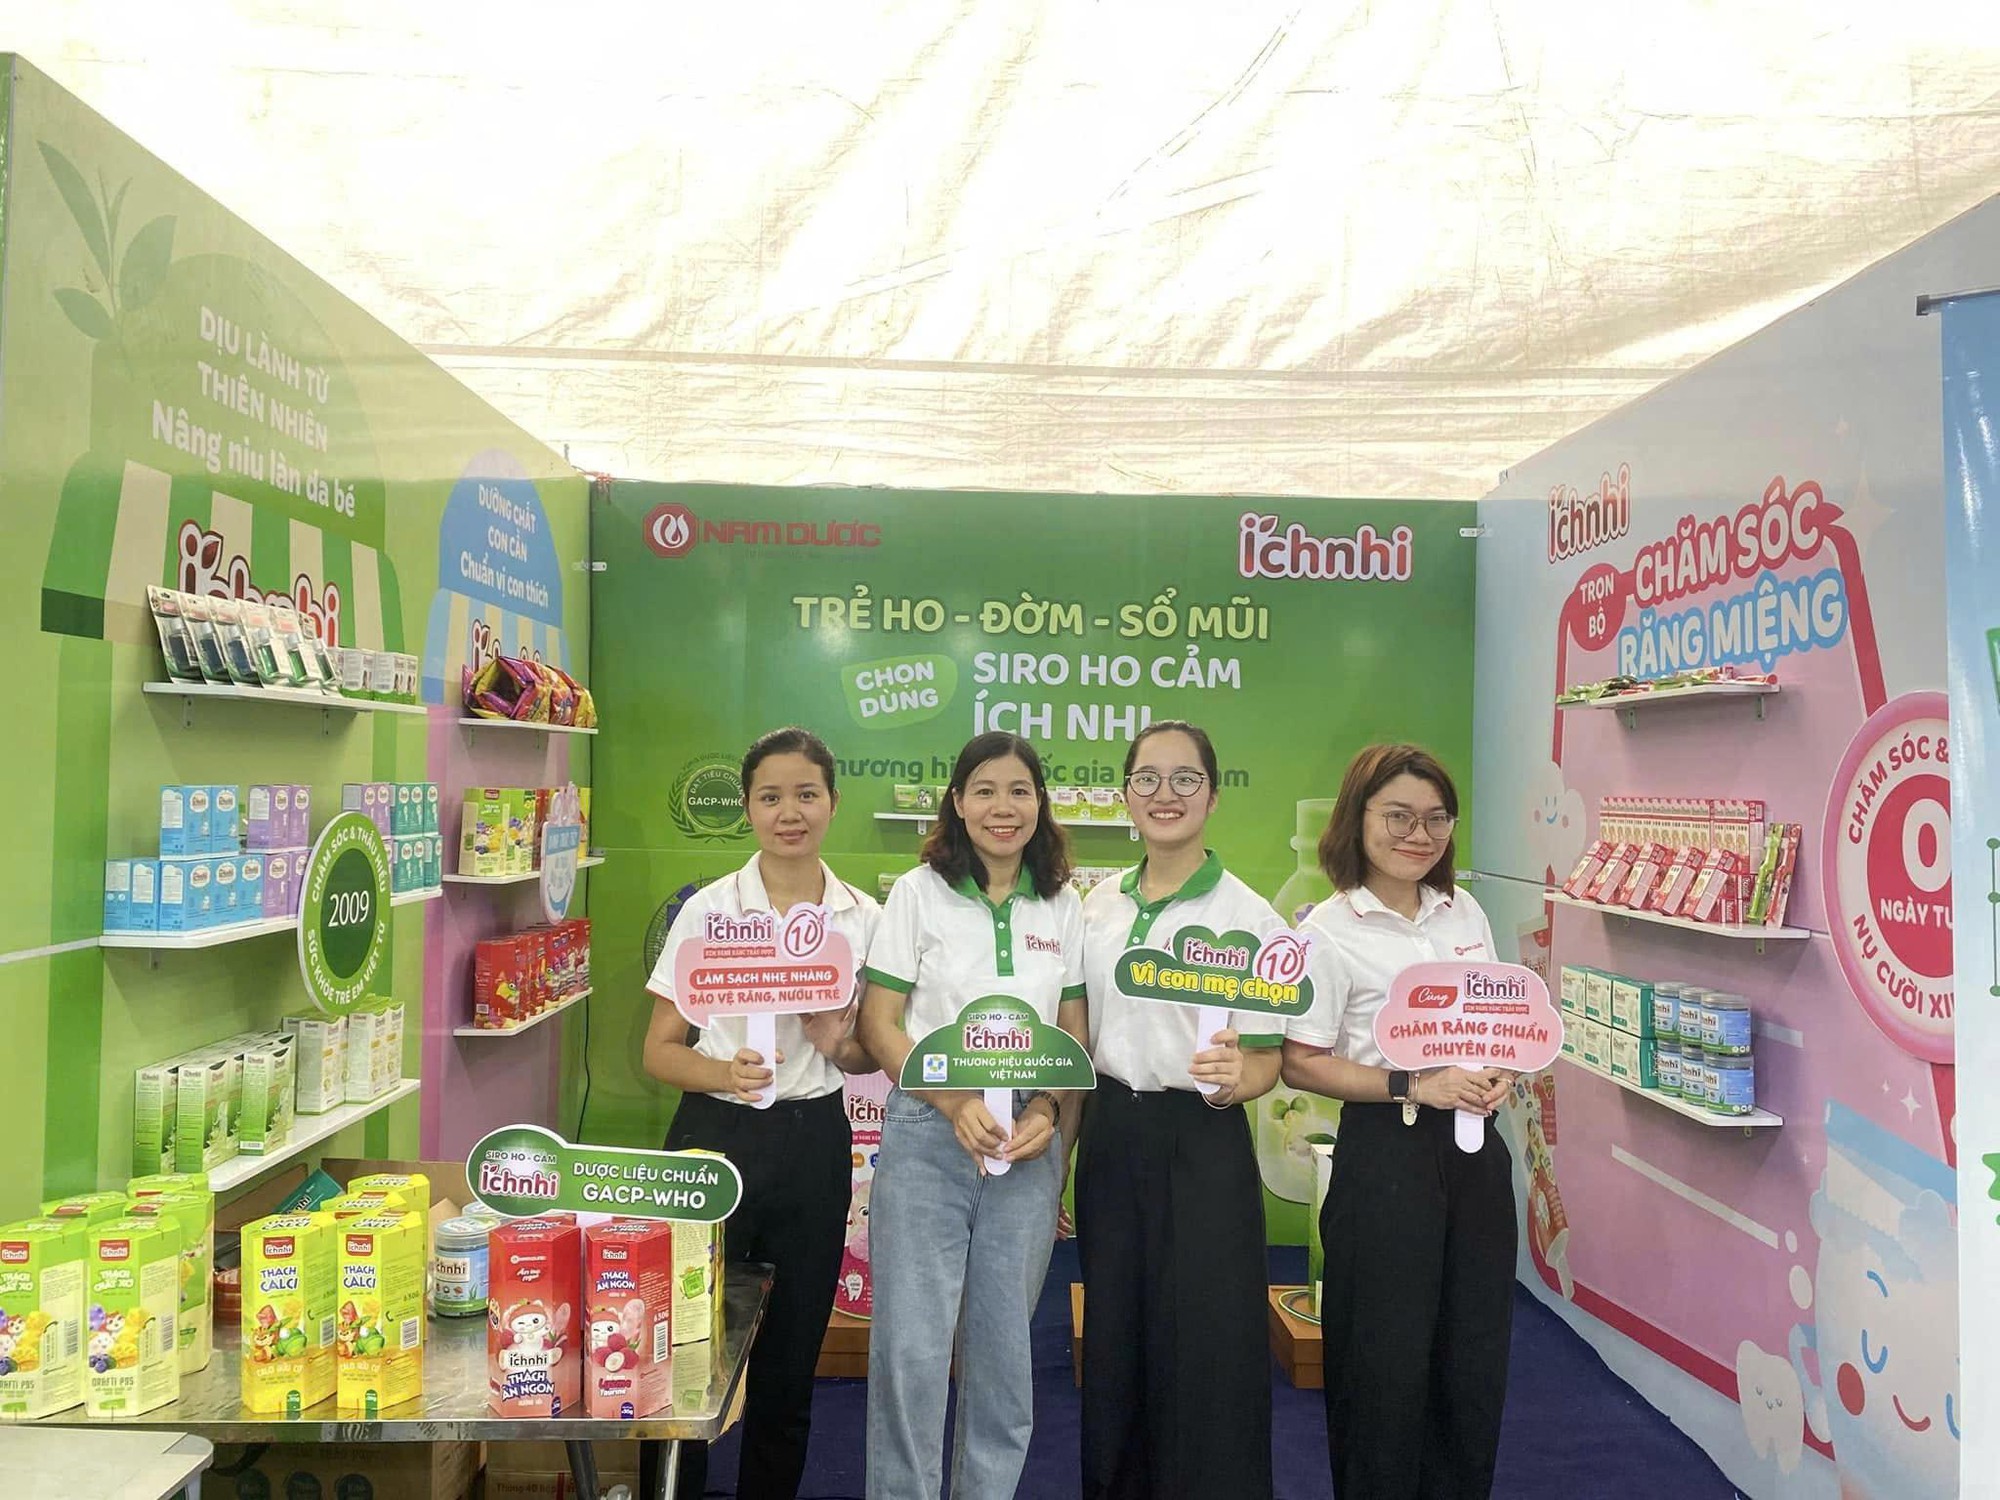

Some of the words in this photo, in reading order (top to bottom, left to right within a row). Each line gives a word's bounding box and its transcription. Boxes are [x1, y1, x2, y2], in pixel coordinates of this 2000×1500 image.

[201, 305, 239, 356] DỊU
[246, 330, 300, 390] LÀNH
[198, 360, 264, 423] THIÊN
[270, 397, 328, 452] NHIÊN
[153, 399, 222, 474] Nâng
[270, 448, 300, 497] làn
[334, 477, 355, 518] bé
[488, 525, 508, 554] CON
[703, 520, 781, 545] NAM
[1635, 517, 1727, 602] CHĂM
[1736, 484, 1819, 569] SÓC
[496, 567, 506, 599] vị
[507, 576, 524, 599] con
[526, 579, 549, 609] thích
[1580, 572, 1615, 606] TRỌN
[793, 584, 872, 631] TRẺ
[883, 599, 945, 633] HO
[979, 592, 1084, 636] ĐỜM
[1119, 587, 1178, 638] SỔ
[1187, 596, 1268, 640] MŨI
[1588, 606, 1606, 641] BỘ
[1620, 614, 1704, 676] RĂNG
[1713, 577, 1842, 664] MIỆNG
[855, 661, 934, 693] CHỌN
[973, 651, 1069, 687] SIRO
[1080, 654, 1141, 689] HO
[1150, 645, 1241, 690] CẢM
[858, 682, 939, 719] DÙNG
[974, 689, 1052, 740] ÍCH
[1067, 703, 1152, 741] NHI
[1074, 759, 1115, 787] gia
[1849, 760, 1888, 845] CHĂM
[1889, 732, 1930, 772] SÓC
[327, 889, 370, 928] 2009
[1880, 895, 1927, 928] NGÀY
[696, 971, 724, 985] LÀM
[727, 972, 759, 987] SẠCH
[762, 971, 787, 985] NHẸ
[791, 968, 832, 982] NHÀNG
[1853, 914, 1878, 961] NỤ
[1877, 960, 1923, 1016] CƯỜI
[350, 981, 365, 1000] EM
[689, 991, 714, 1005] BẢO
[717, 991, 734, 1006] VỆ
[738, 989, 775, 1004] RĂNG,
[816, 986, 840, 1001] TRẺ
[1130, 961, 1156, 985] Vì
[1158, 969, 1199, 990] con
[1203, 973, 1239, 1000] mẹ
[1241, 977, 1299, 1006] chọn
[1418, 987, 1449, 1007] Cùng
[989, 1013, 1002, 1021] HO
[1390, 1020, 1437, 1039] CHĂM
[1441, 1018, 1488, 1035] RĂNG
[1492, 1021, 1548, 1043] CHUẨN
[953, 1057, 997, 1067] THƯƠNG
[998, 1056, 1022, 1069] HIỆU
[1024, 1053, 1053, 1067] QUỐC
[1055, 1057, 1073, 1067] GIA
[1422, 1039, 1485, 1057] CHUYÊN
[1491, 1043, 1516, 1059] GIA
[989, 1068, 1012, 1080] VIỆT
[1013, 1069, 1037, 1079] NAM
[486, 1150, 508, 1161] SIRO
[511, 1152, 525, 1162] HO
[573, 1162, 619, 1181] DƯỢC
[623, 1165, 659, 1183] LIỆU
[662, 1164, 718, 1186] CHUẨN
[582, 1183, 707, 1210] GACP-WHO
[260, 1277, 298, 1292] CALCI
[343, 1275, 376, 1289] CALCI
[609, 1279, 636, 1290] NGON
[520, 1382, 554, 1397] NGON
